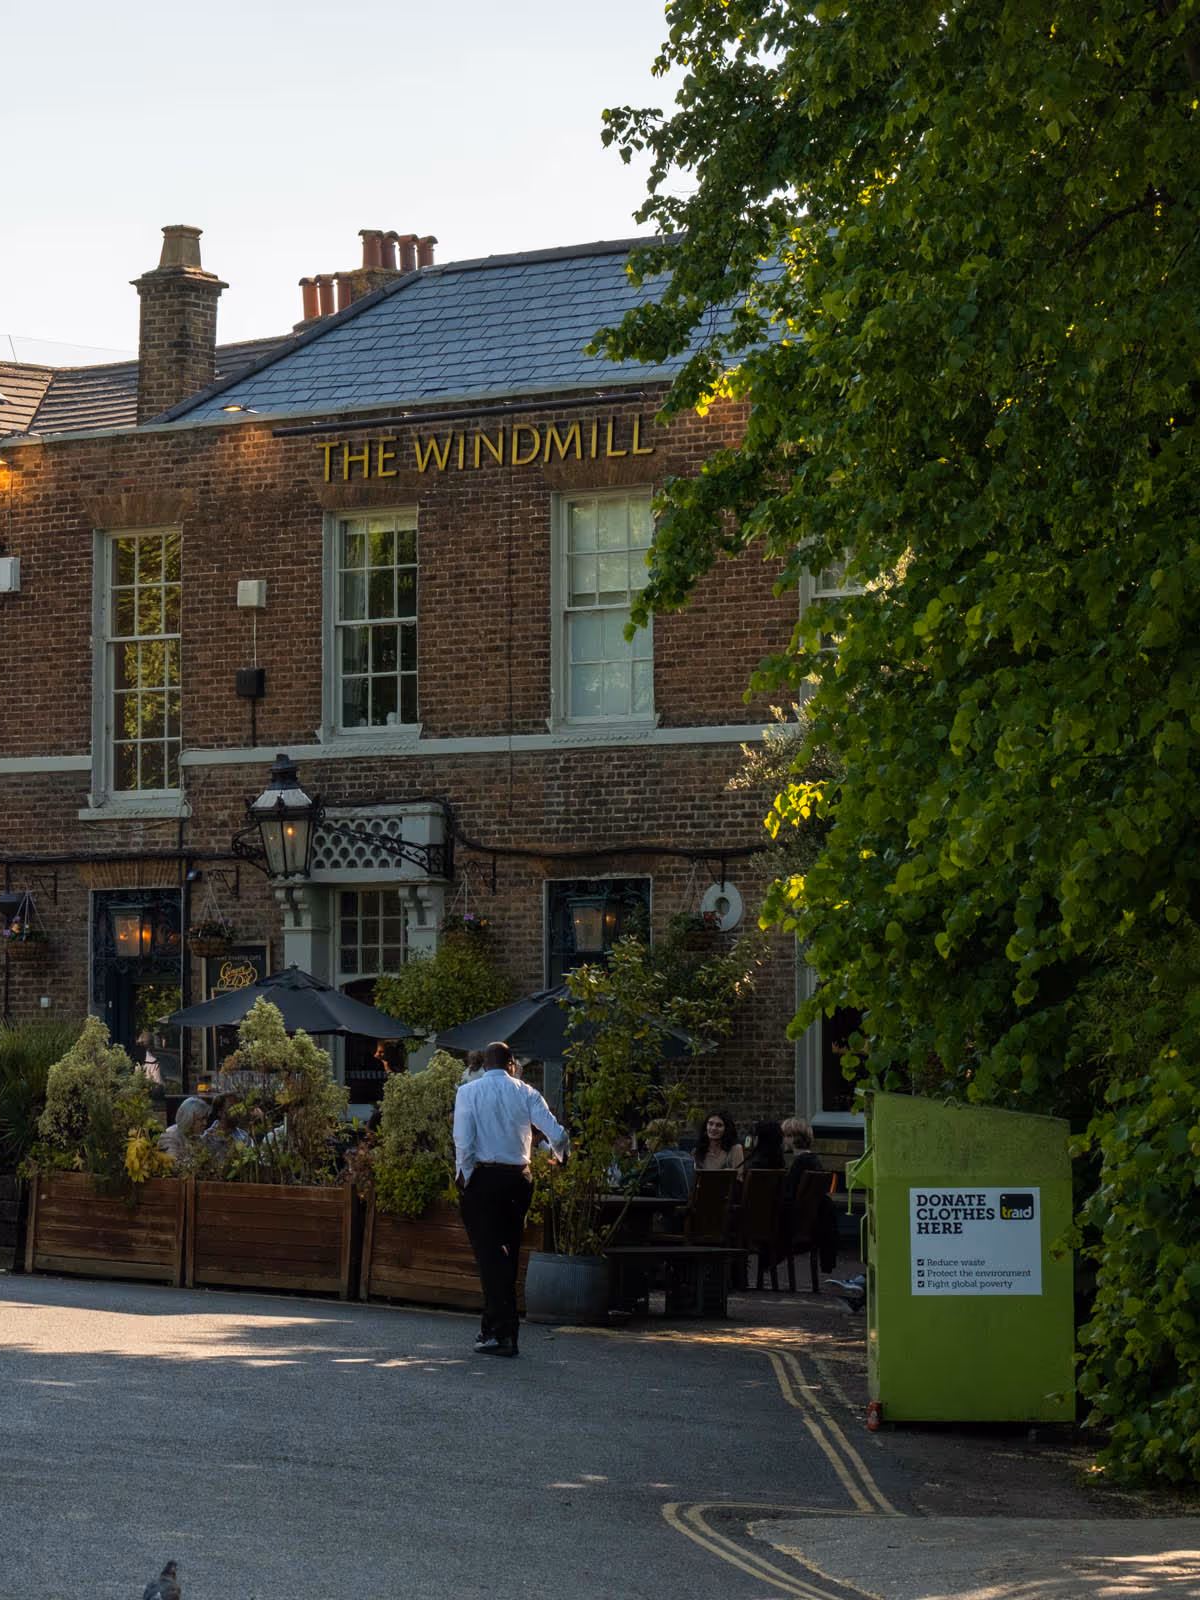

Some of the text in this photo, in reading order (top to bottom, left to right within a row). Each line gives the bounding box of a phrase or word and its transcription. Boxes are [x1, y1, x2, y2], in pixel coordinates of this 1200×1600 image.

[314, 413, 656, 483] THE WINDMILL
[916, 1194, 986, 1207] DONATE
[916, 1208, 995, 1220] CLOTHES
[1002, 1206, 1032, 1218] traid
[916, 1222, 963, 1234] HERE
[927, 1258, 959, 1266] Reduce
[927, 1269, 1032, 1277] Protect the environment
[927, 1280, 1013, 1289] Fight global poverty
